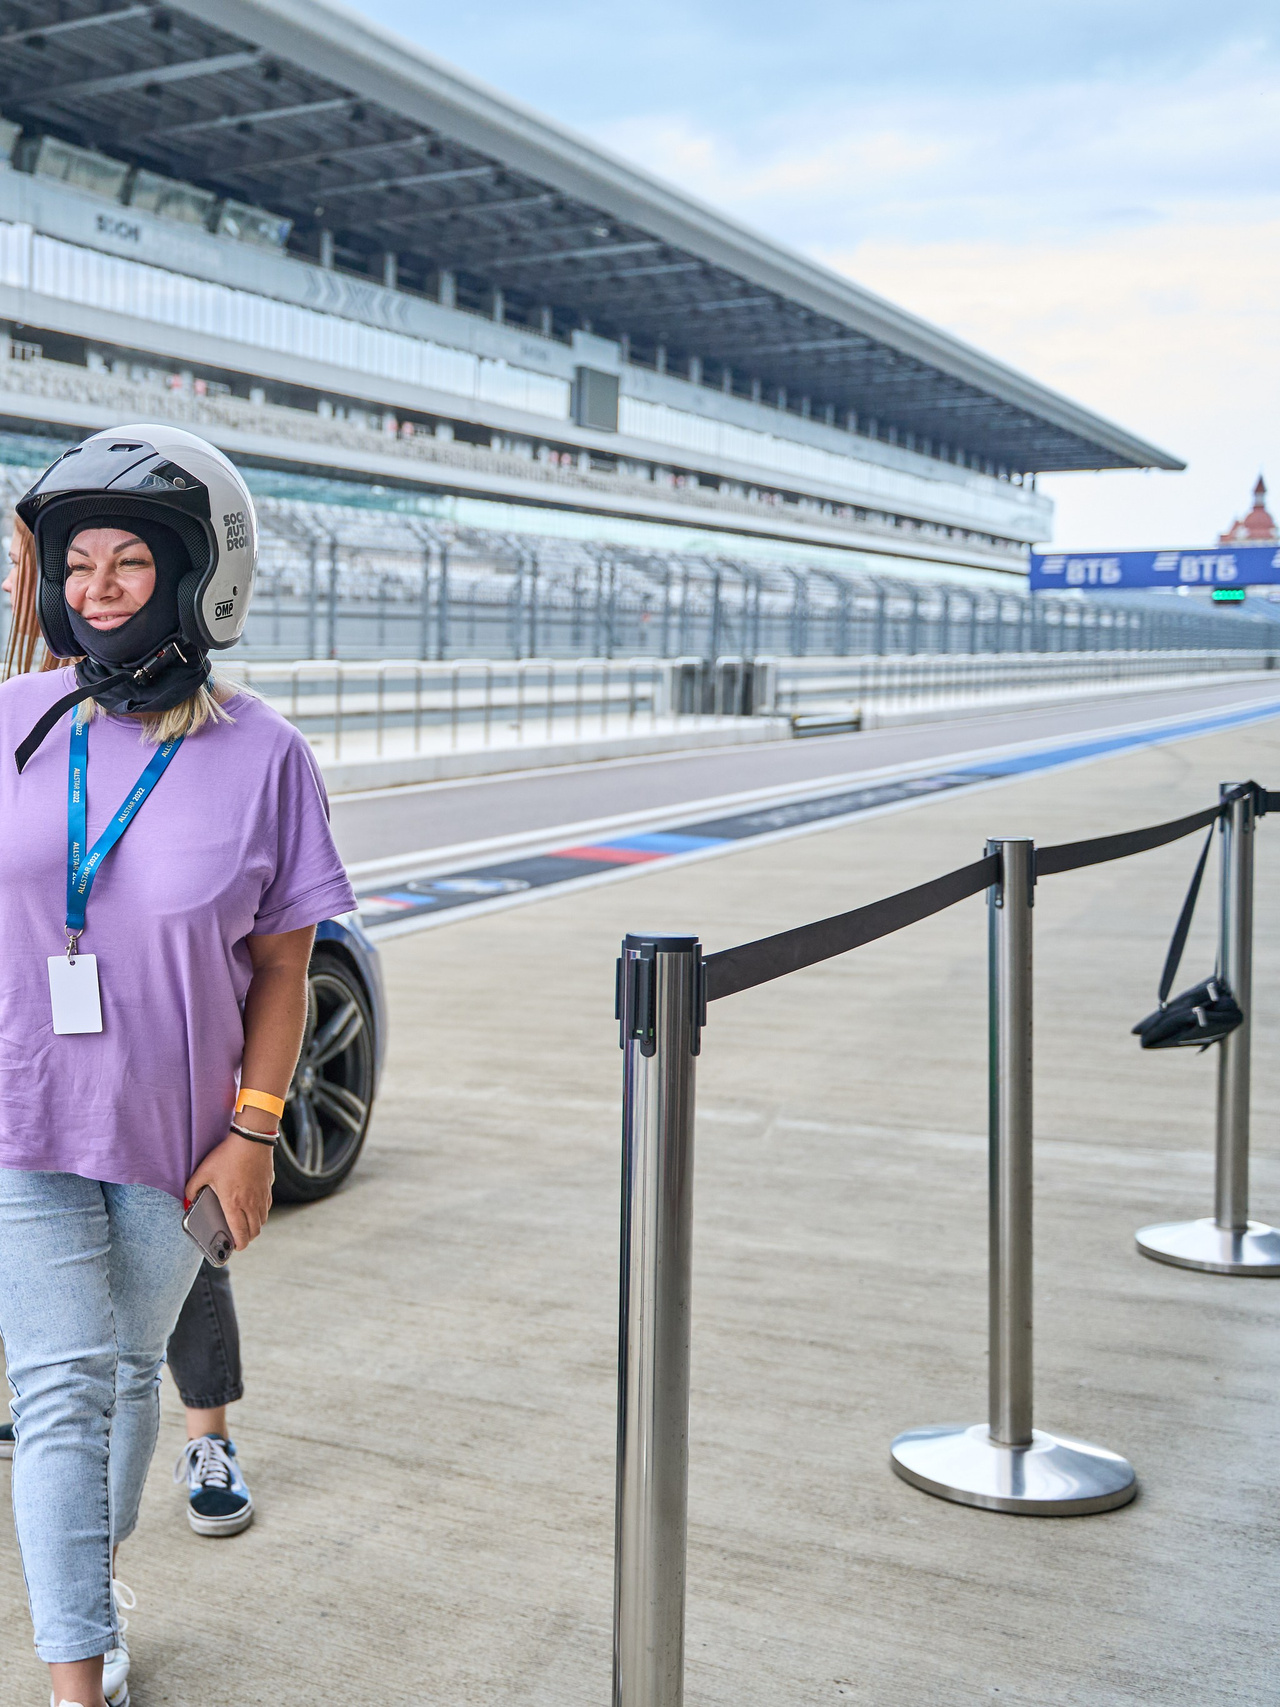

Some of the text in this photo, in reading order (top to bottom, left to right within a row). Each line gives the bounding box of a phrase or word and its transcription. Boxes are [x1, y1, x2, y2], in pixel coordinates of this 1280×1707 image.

[223, 511, 247, 527] SOCH
[1065, 557, 1121, 585] ВТБ
[1179, 554, 1238, 582] ВТБ
[215, 602, 233, 617] OMP
[72, 767, 81, 804] ALLSTAR 2022
[118, 787, 146, 823] ALLSTAR 2022
[77, 852, 101, 895] ALLSTAR 2022
